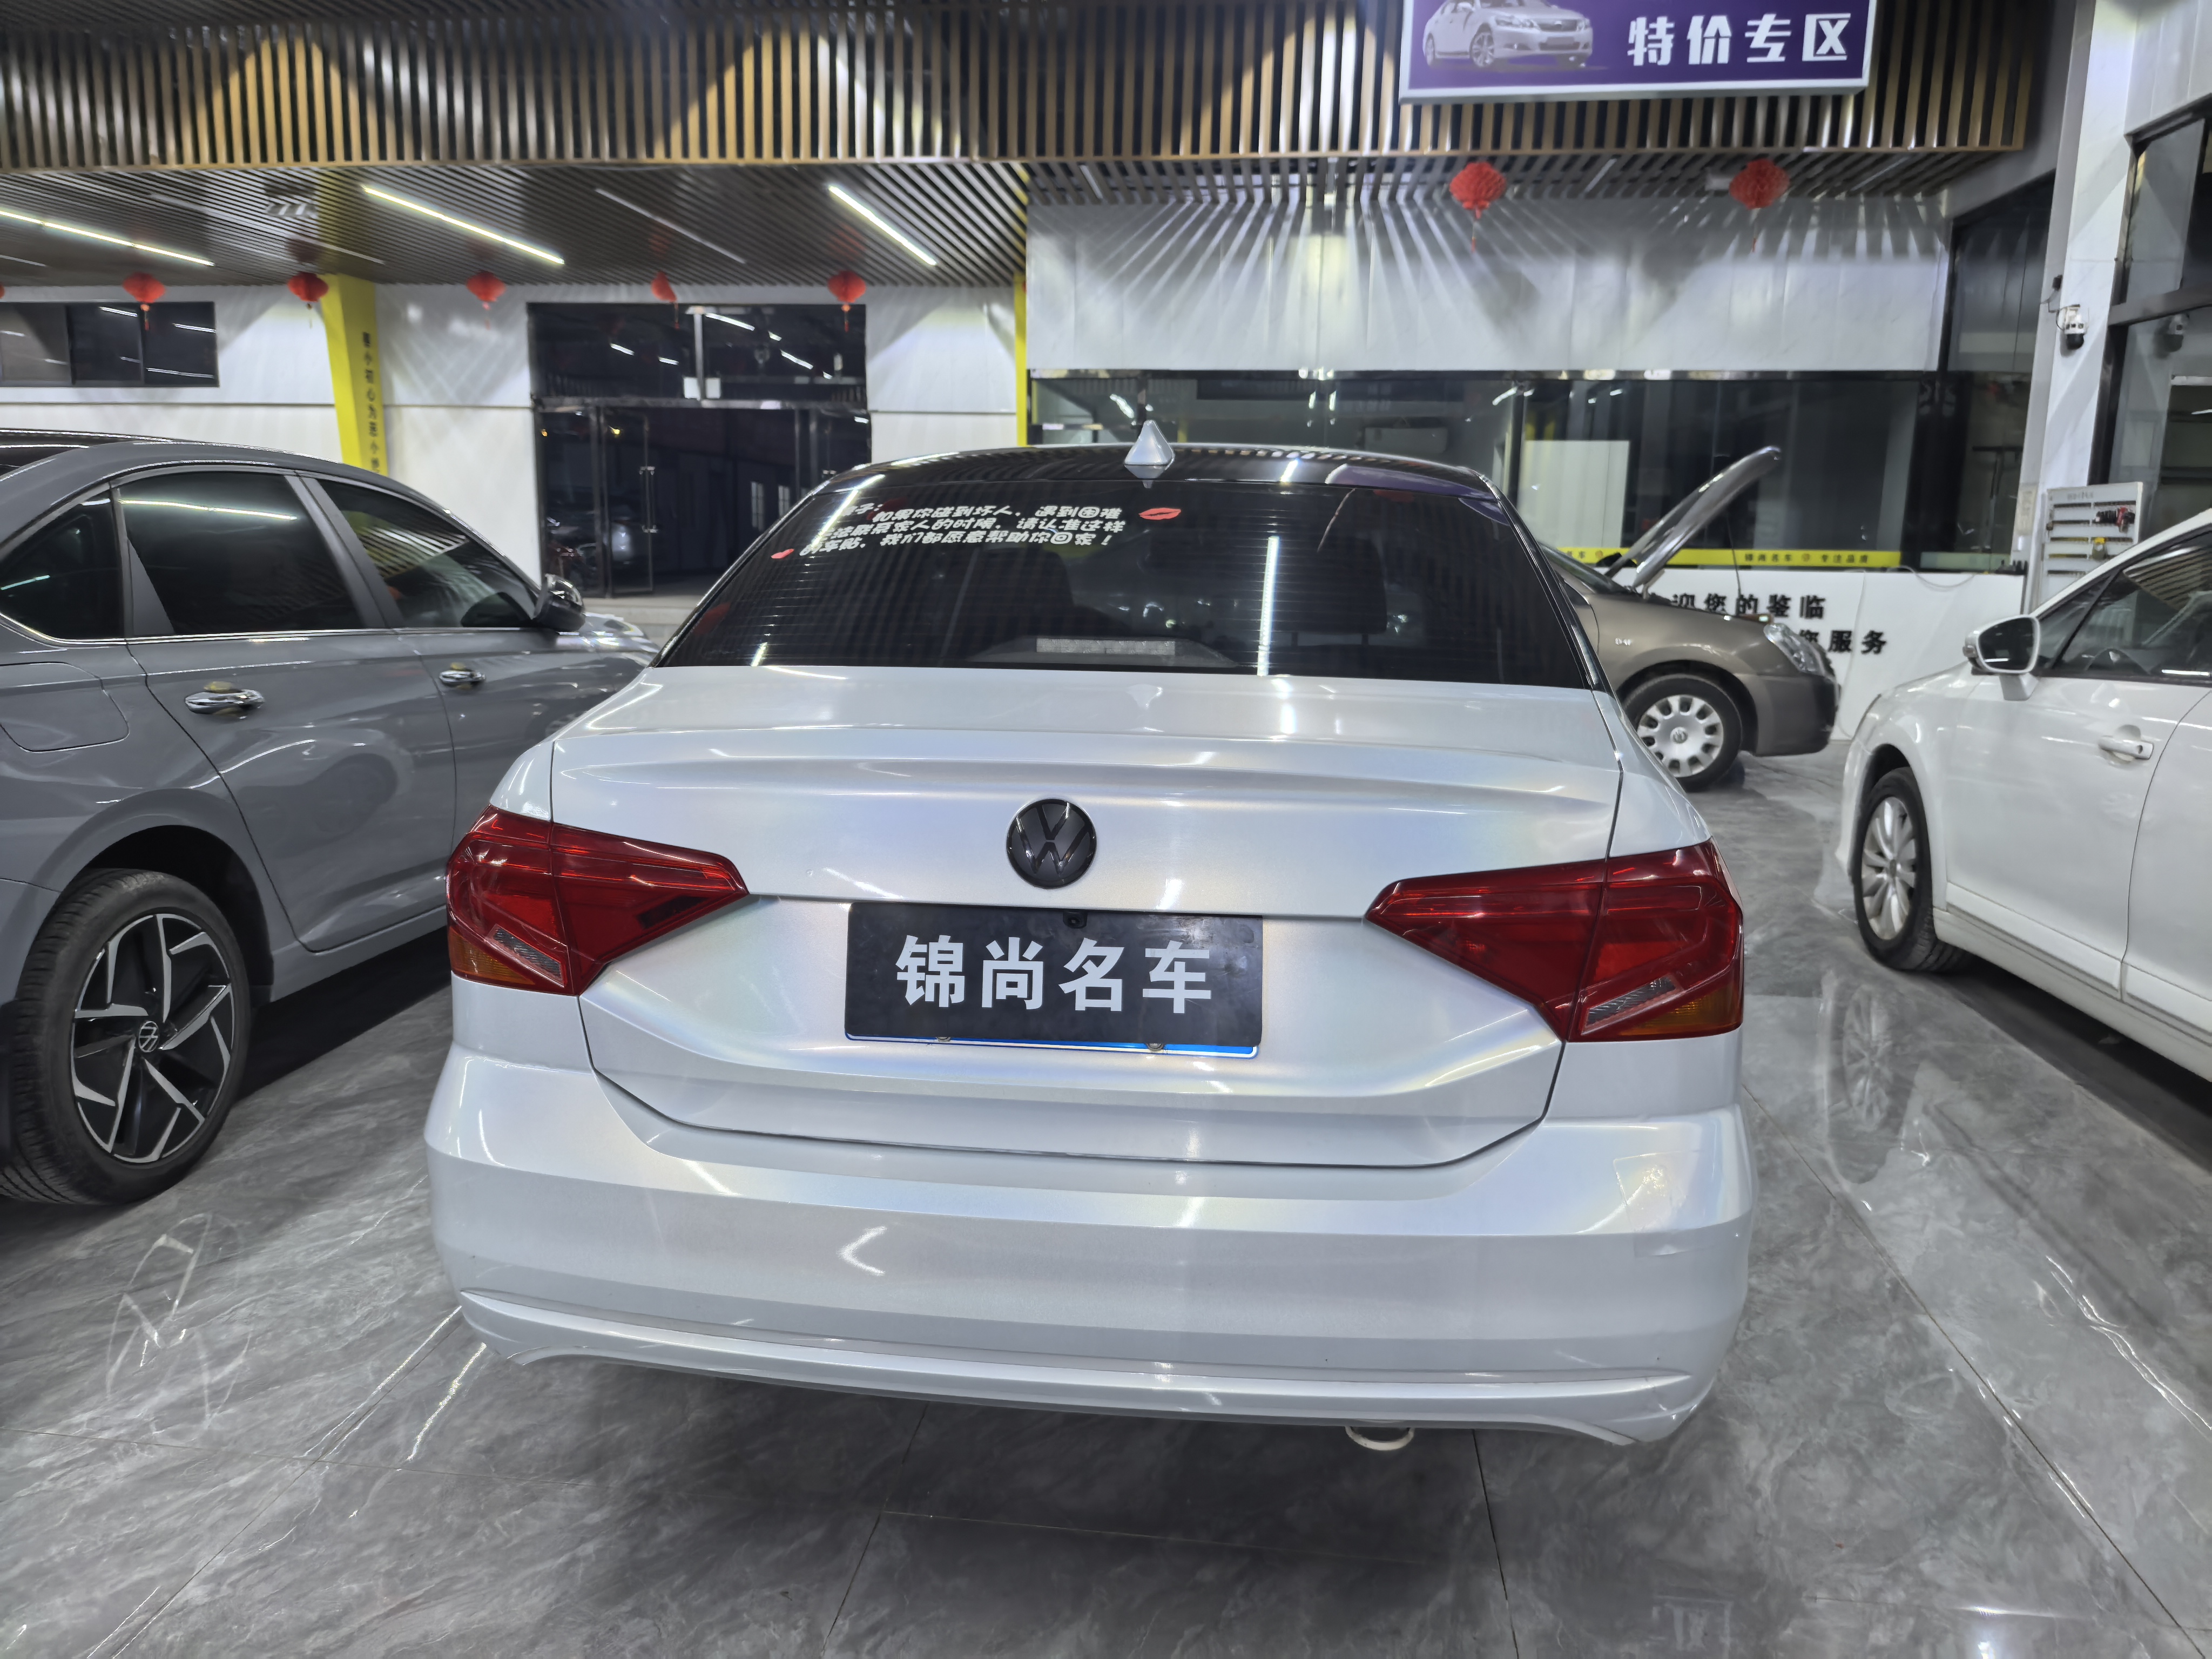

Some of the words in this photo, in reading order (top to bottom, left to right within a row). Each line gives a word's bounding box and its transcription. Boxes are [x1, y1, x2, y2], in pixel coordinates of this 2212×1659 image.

[1627, 12, 1852, 66] 特价专区
[895, 934, 1212, 1014] 锦尚名车
